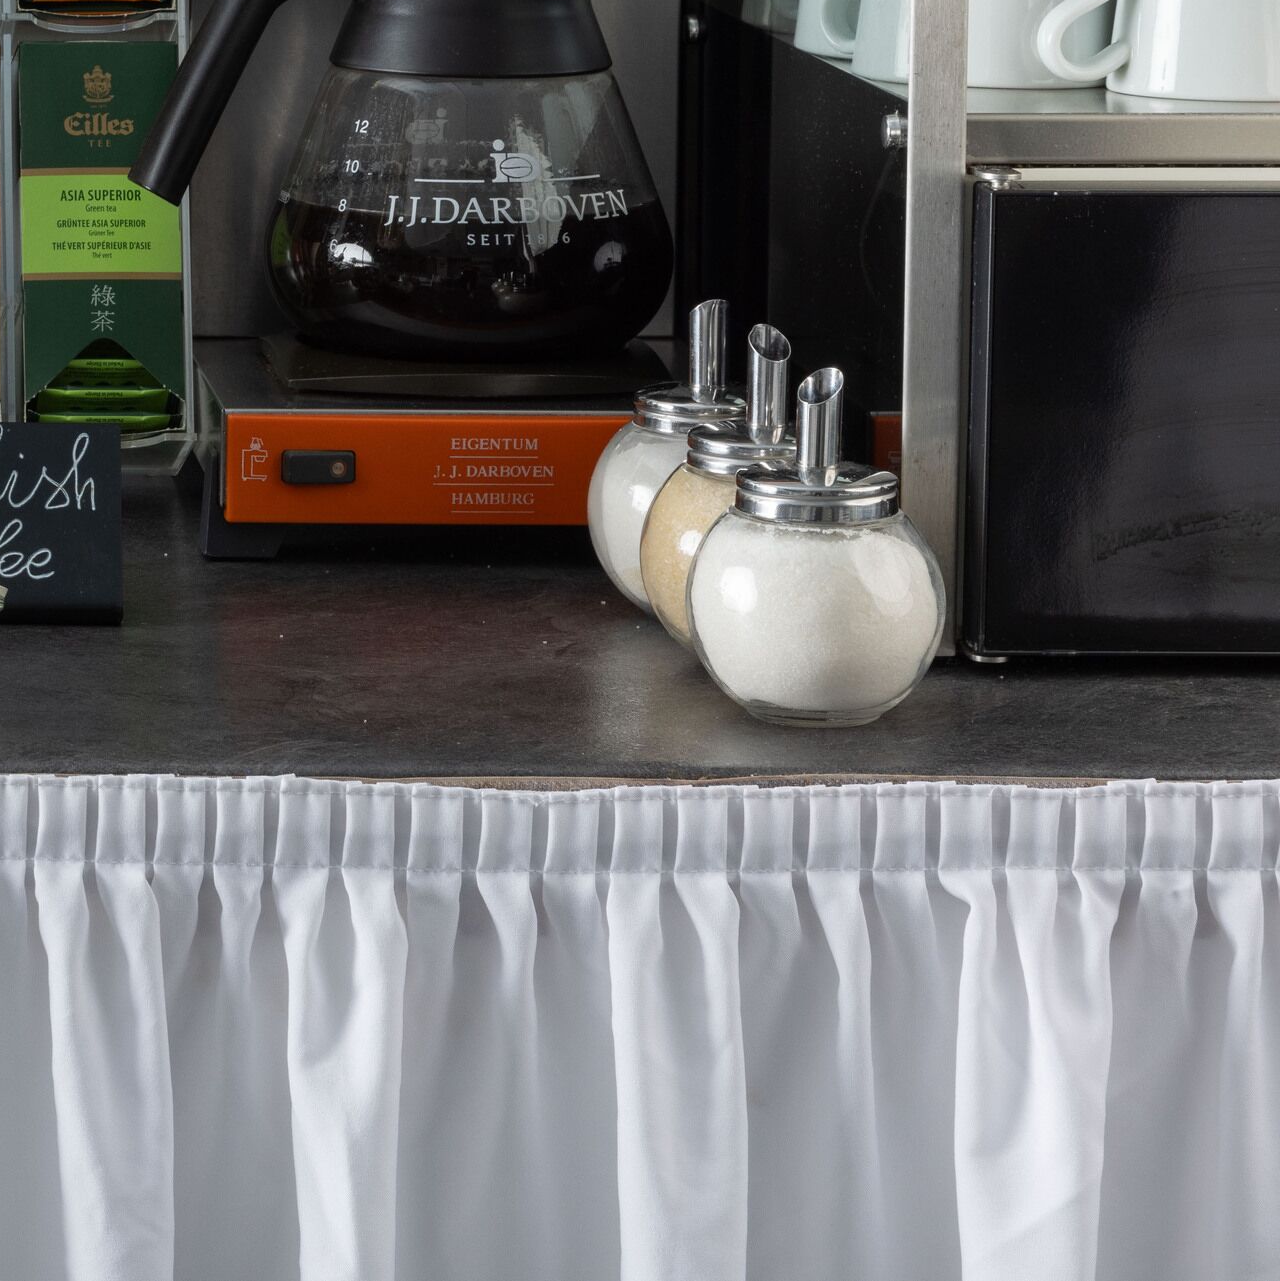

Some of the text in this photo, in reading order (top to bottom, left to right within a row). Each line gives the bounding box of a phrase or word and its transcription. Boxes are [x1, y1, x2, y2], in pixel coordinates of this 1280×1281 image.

[63, 111, 135, 136] Eilles
[354, 119, 370, 135] 12
[88, 139, 112, 148] TEE
[344, 159, 360, 174] 10
[60, 189, 142, 202] ASIA SUPERIOR
[85, 204, 117, 213] Green tea
[337, 198, 348, 213] 8
[56, 217, 146, 228] GRÜNTEE ASIA SUPERIOR
[52, 239, 151, 251] THÉ VERT SUPÉRIEUR D'ASIE
[466, 233, 516, 247] SEIT
[450, 437, 539, 451] EIGENTUM
[466, 464, 555, 478] DARBOVEN
[451, 492, 536, 506] HAMBURG
